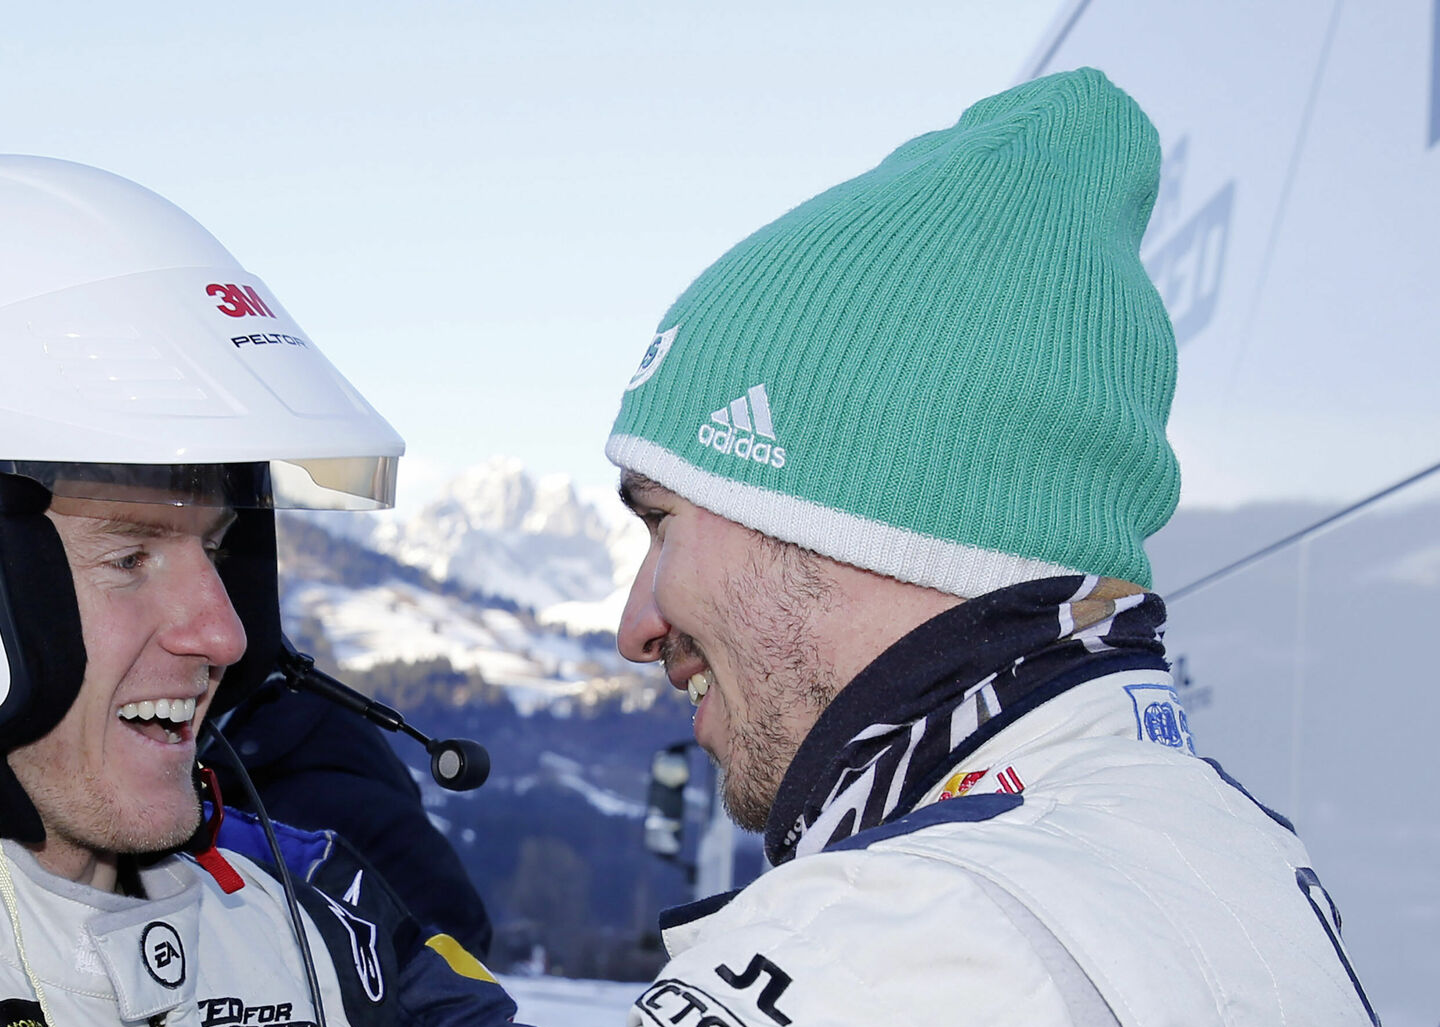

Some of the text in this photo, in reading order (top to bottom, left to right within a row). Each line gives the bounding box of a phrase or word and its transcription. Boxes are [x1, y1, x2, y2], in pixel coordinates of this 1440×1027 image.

[205, 283, 278, 319] 3M
[230, 333, 309, 349] PELTOR
[698, 423, 786, 469] adidas
[153, 940, 181, 969] EA
[243, 1002, 293, 1025] FOR
